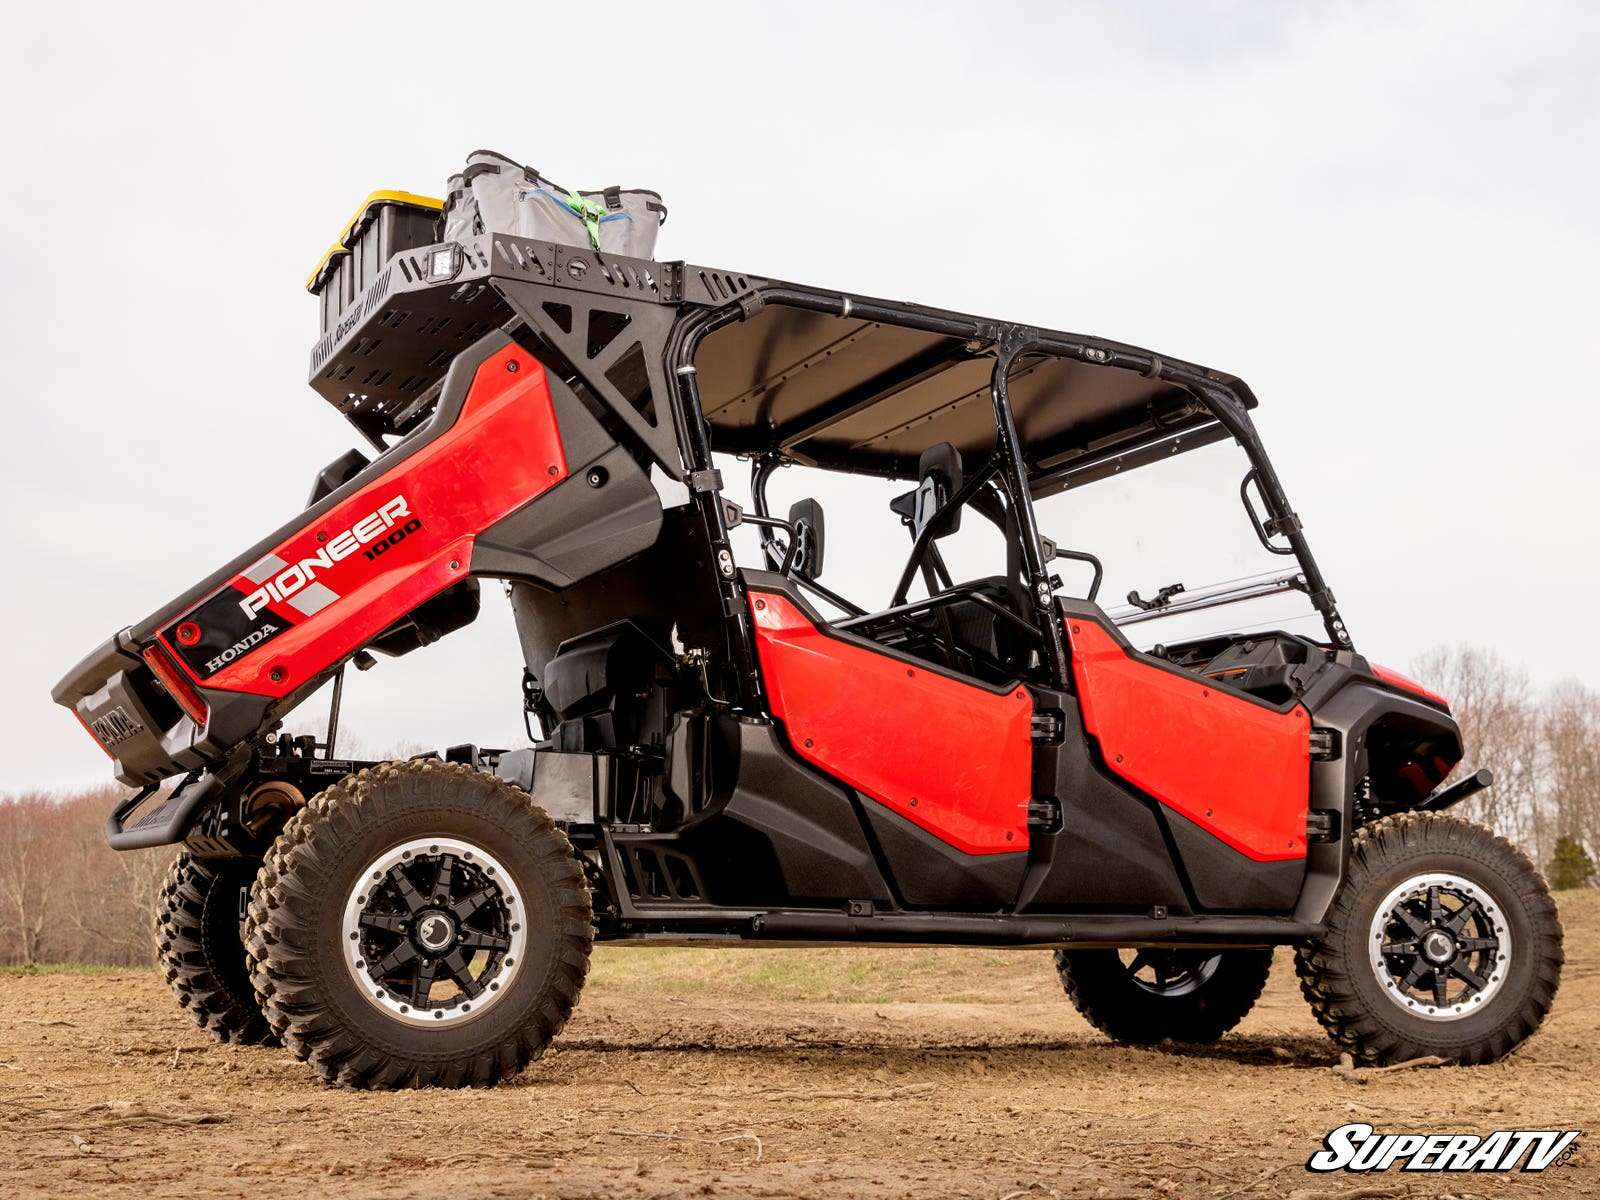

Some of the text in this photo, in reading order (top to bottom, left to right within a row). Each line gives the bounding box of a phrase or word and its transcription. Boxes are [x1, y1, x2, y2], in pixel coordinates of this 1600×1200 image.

[239, 495, 412, 621] PIONEER
[362, 518, 422, 561] 1000
[205, 624, 278, 672] HONDA
